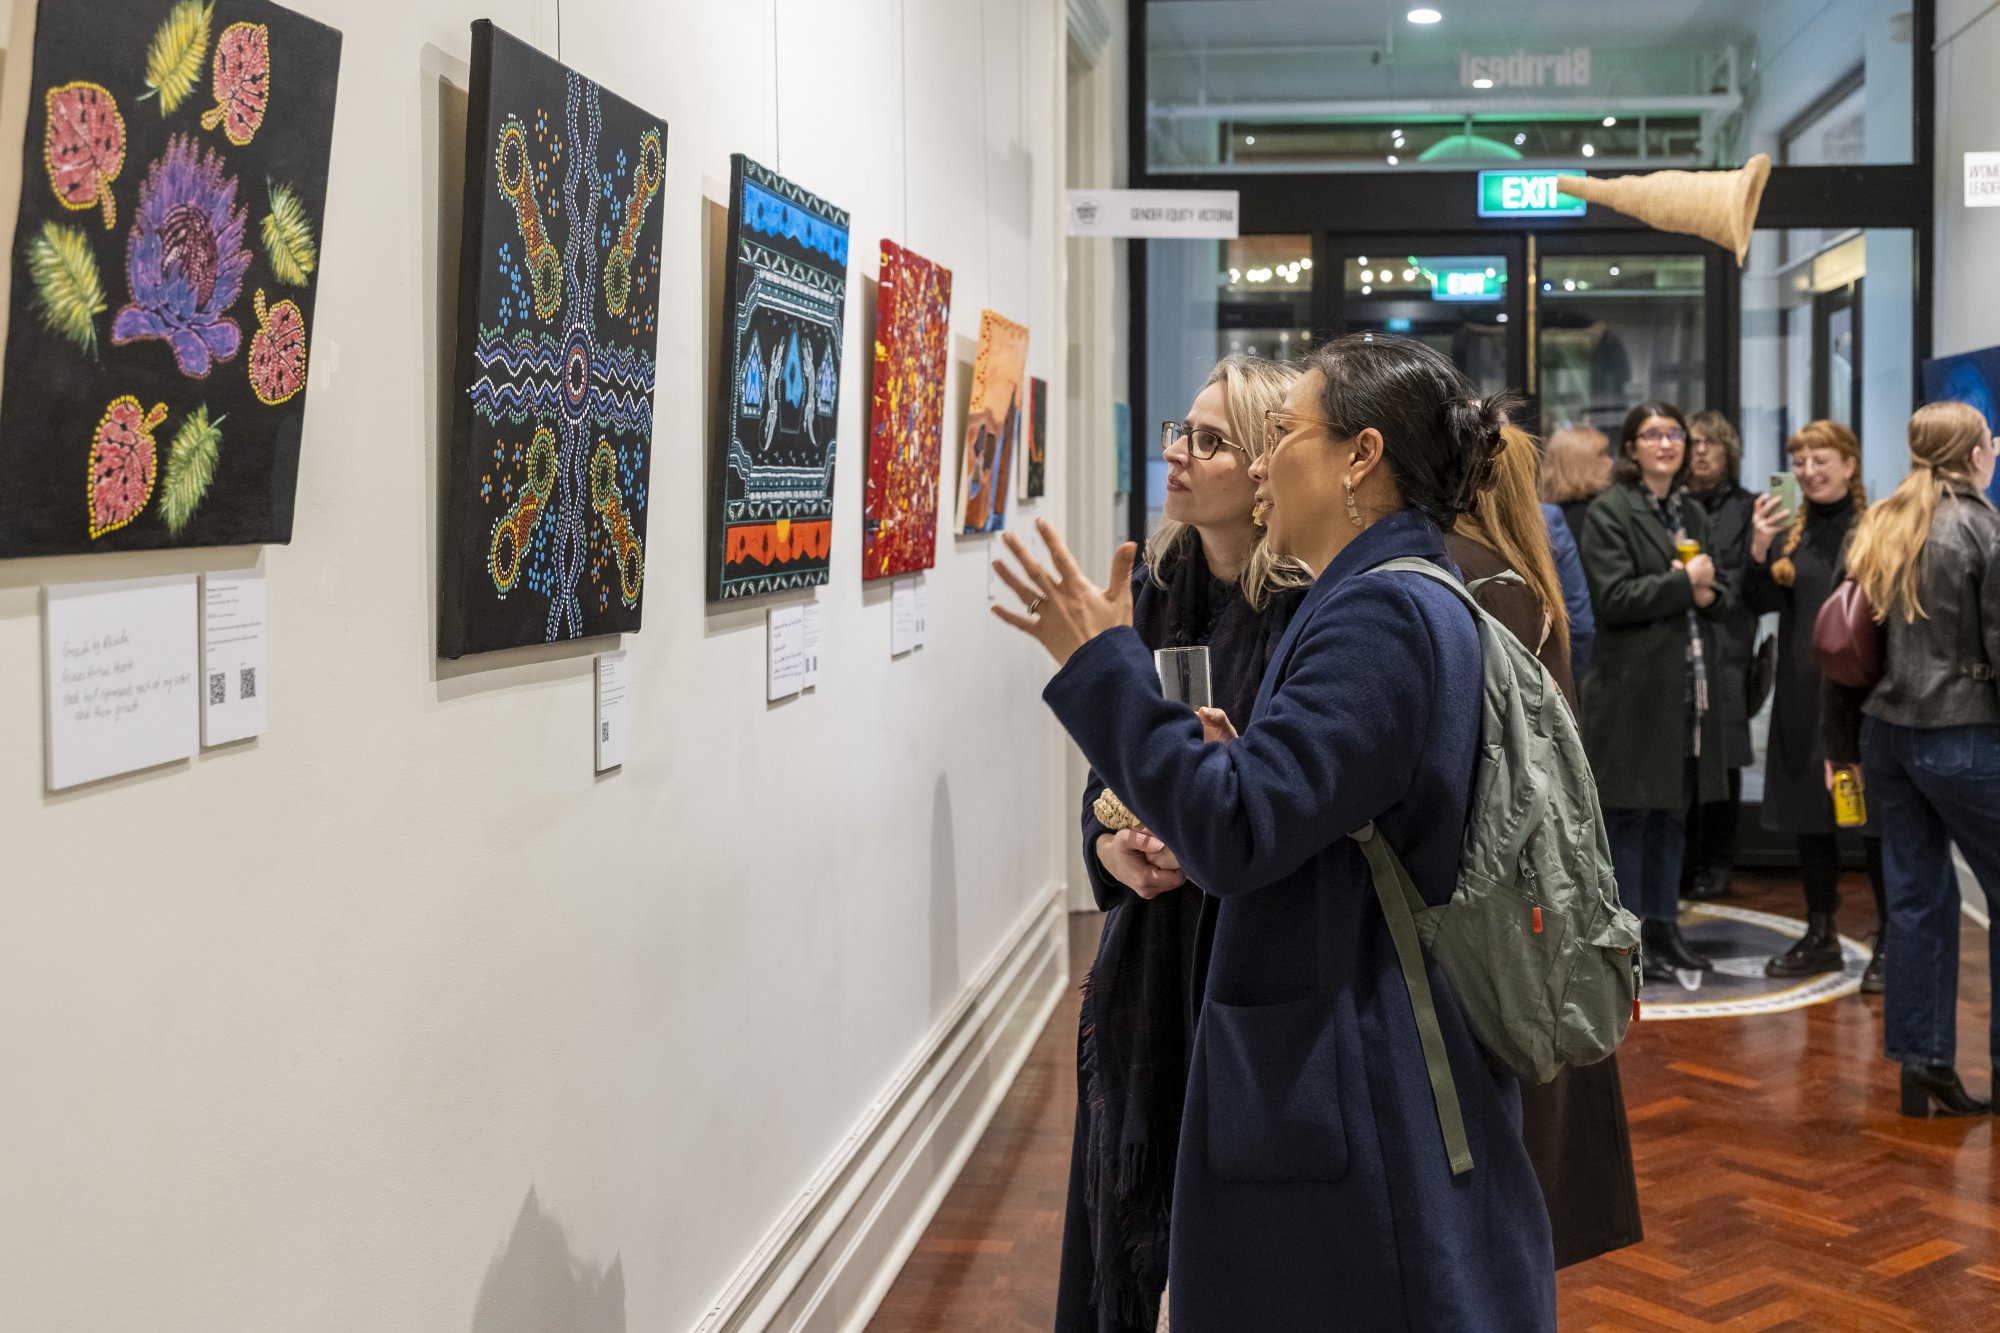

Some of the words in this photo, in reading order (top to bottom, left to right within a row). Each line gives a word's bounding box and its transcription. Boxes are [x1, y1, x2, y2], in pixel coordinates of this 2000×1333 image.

[1502, 176, 1558, 209] EXIT
[1130, 207, 1163, 221] GENDER
[1165, 207, 1194, 223] EQUITY
[1197, 207, 1235, 222] VICTORIA
[1447, 273, 1484, 296] EXIT
